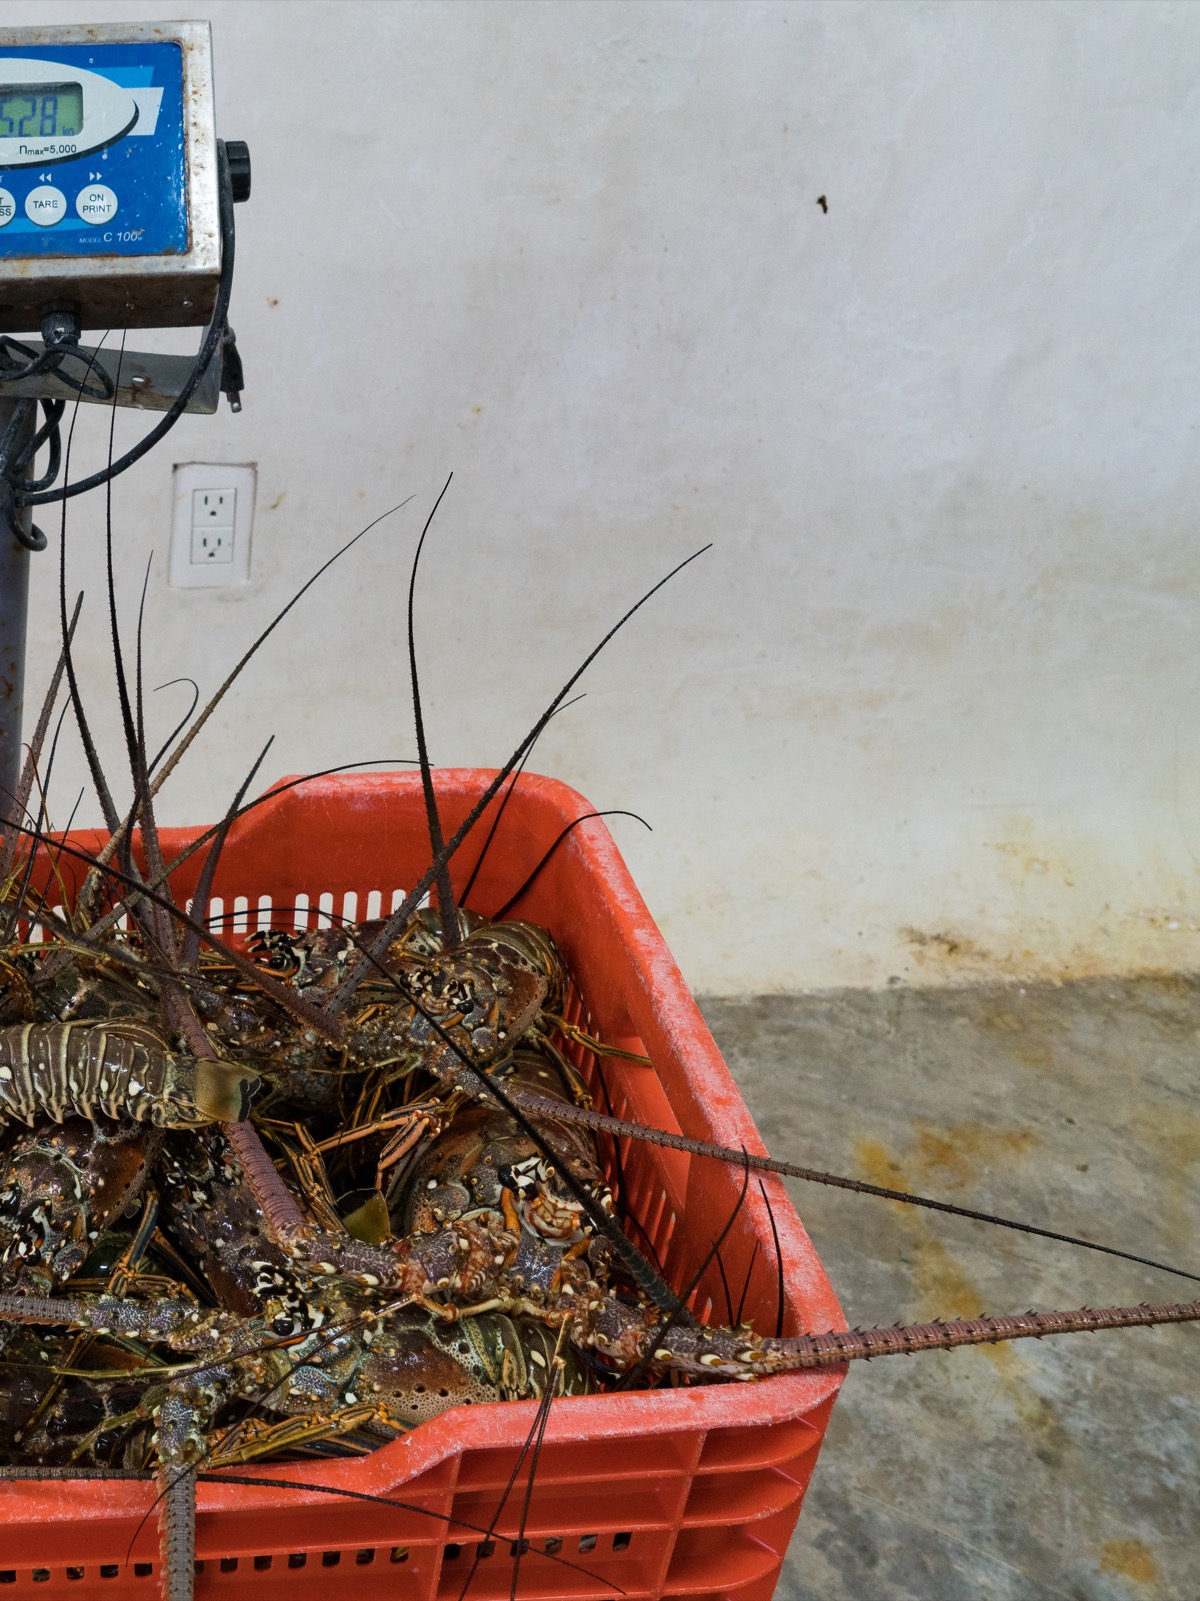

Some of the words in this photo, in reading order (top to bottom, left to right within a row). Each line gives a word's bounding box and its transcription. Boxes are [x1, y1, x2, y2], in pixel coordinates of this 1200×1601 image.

[89, 194, 104, 202] ON
[33, 200, 59, 209] TARE
[82, 204, 112, 213] PRINT
[103, 232, 112, 242] C
